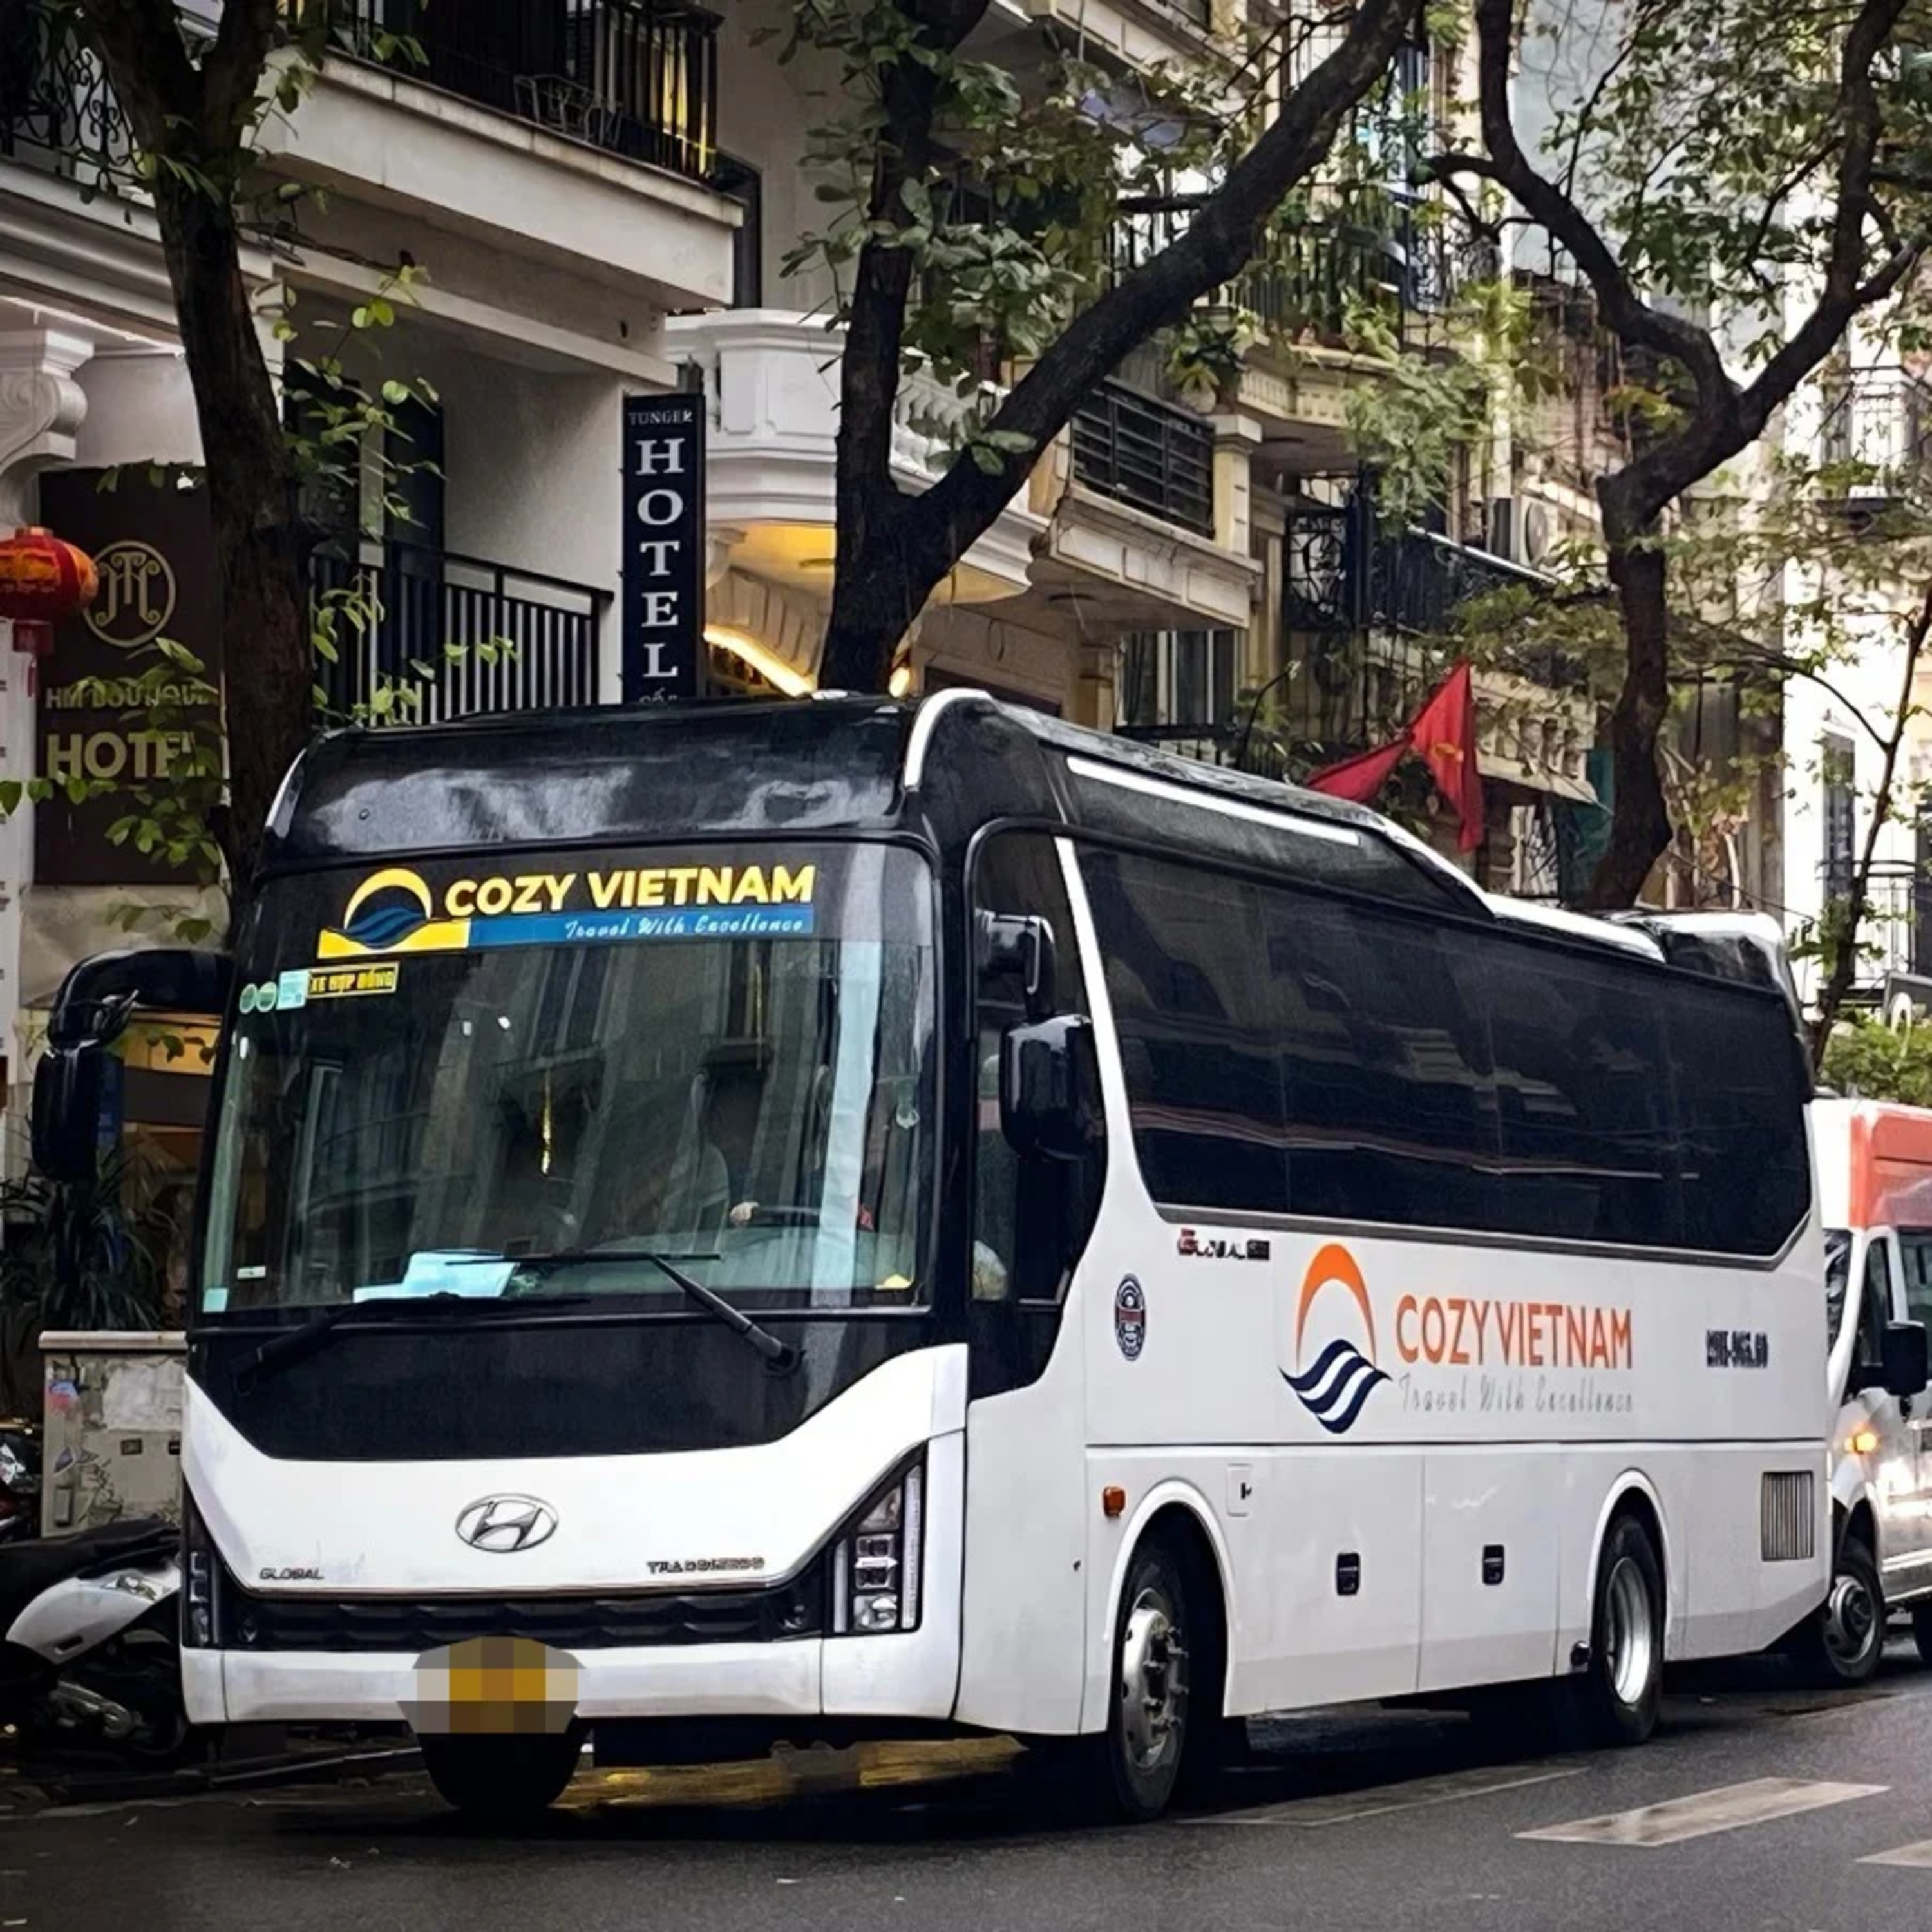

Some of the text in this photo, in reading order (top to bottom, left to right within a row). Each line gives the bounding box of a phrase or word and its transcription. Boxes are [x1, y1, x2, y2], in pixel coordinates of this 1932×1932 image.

[635, 438, 685, 678] HOTEL
[444, 866, 816, 918] COZY VIETNAM
[565, 913, 804, 940] Travel With Excellence
[1396, 1294, 1490, 1366] COZY
[1494, 1300, 1633, 1370] VIETNAM
[1398, 1372, 1633, 1412] Travel With Excellence
[259, 1567, 325, 1580] GLOBAL
